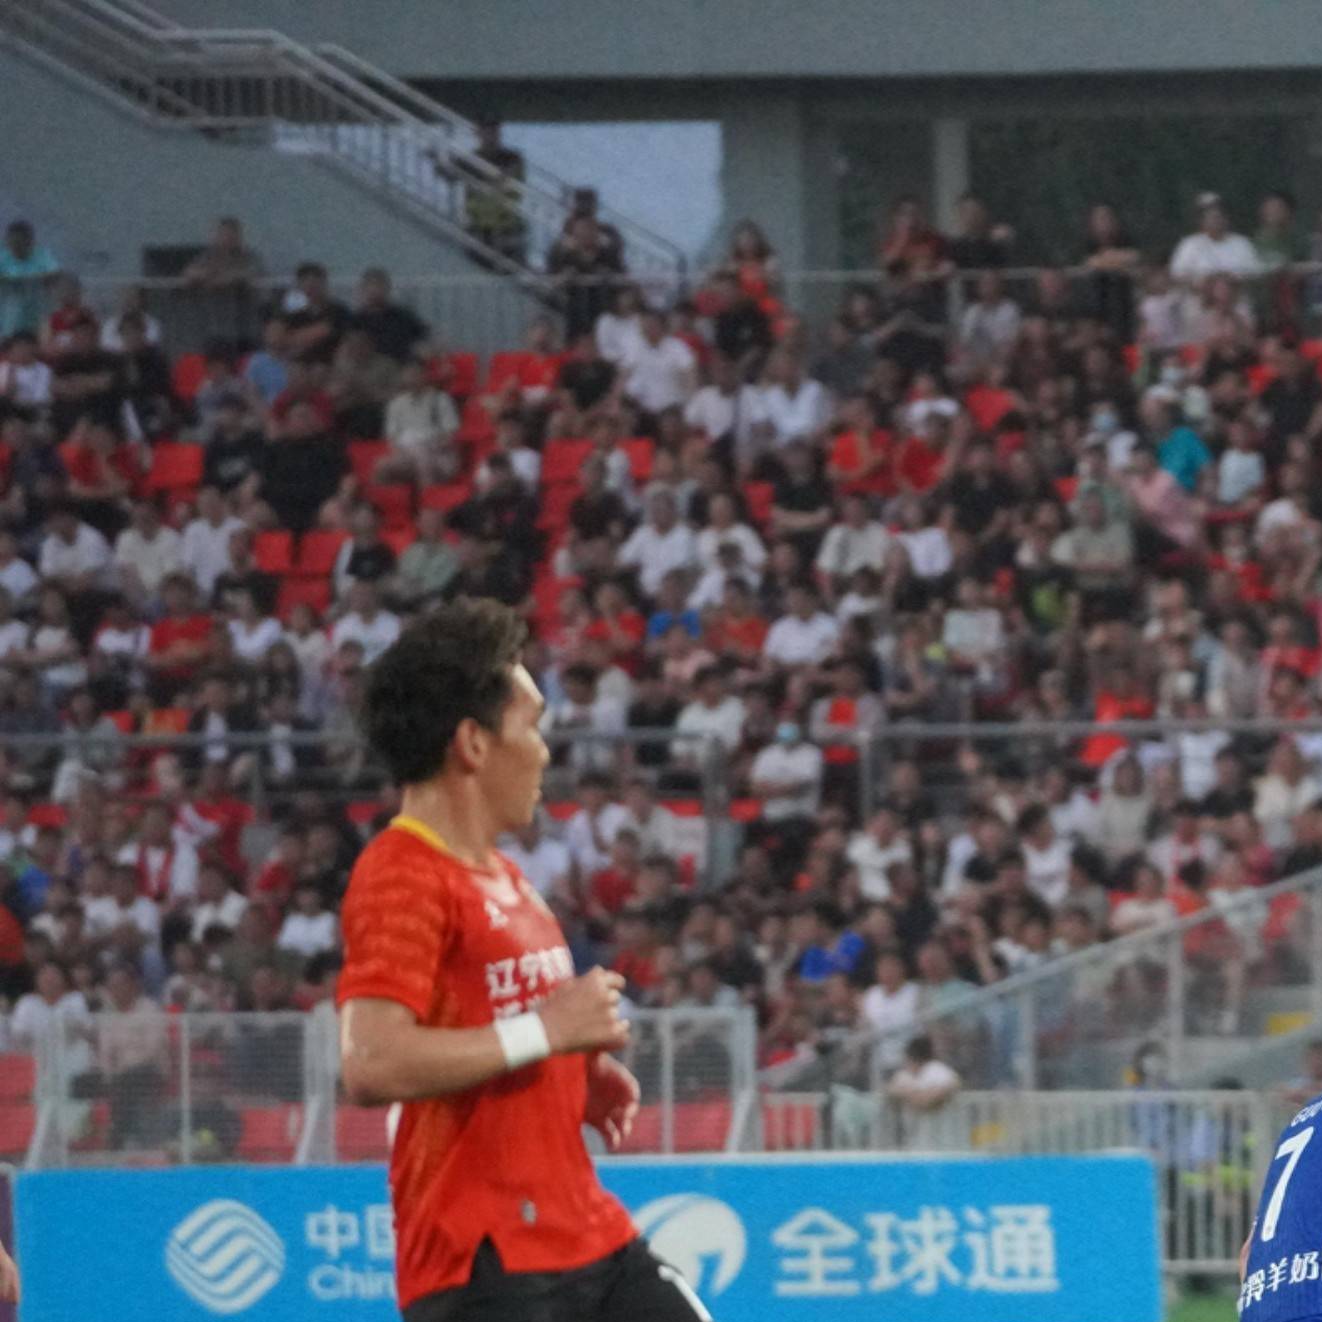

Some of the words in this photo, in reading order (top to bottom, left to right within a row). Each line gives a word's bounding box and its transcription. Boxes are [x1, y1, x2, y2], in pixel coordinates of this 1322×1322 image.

[1260, 1126, 1314, 1242] 7
[771, 1205, 1060, 1296] 全球通
